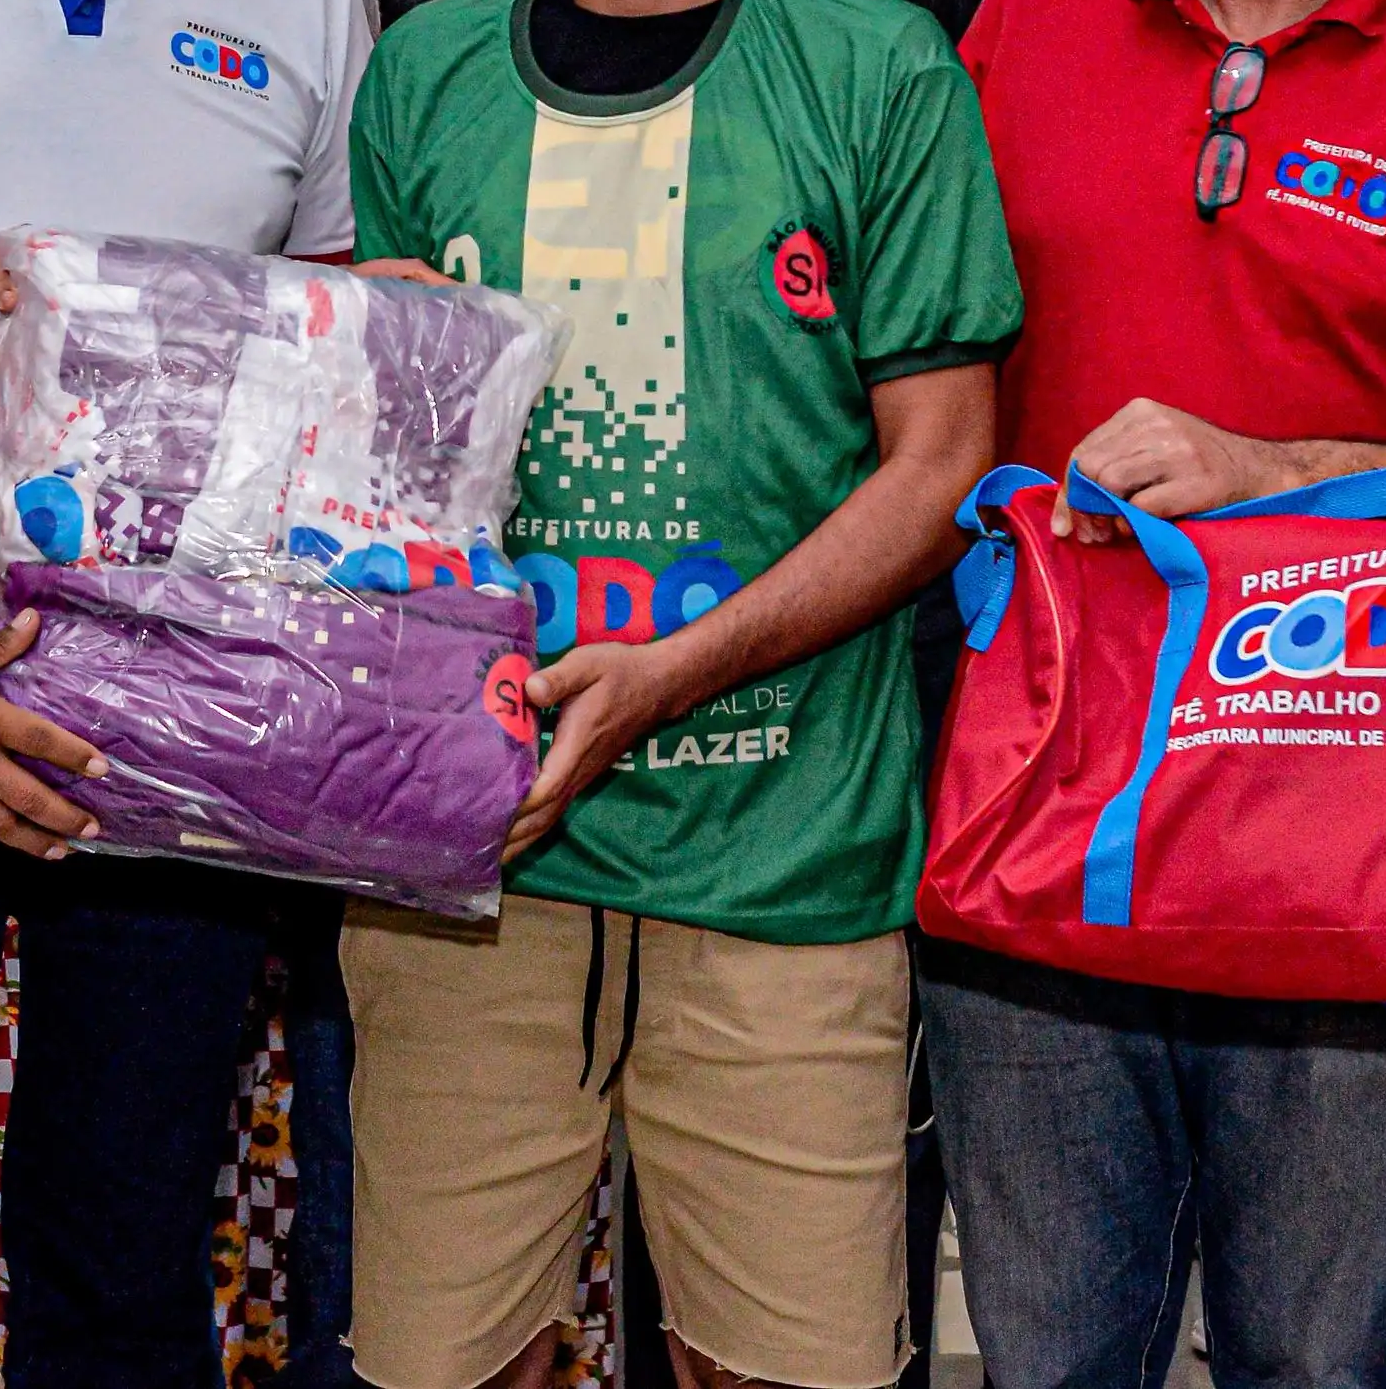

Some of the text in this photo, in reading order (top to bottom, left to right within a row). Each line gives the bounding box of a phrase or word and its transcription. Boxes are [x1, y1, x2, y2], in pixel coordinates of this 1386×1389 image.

[187, 21, 262, 52] PREFEITURA DE
[170, 31, 270, 91] CODÓ
[507, 517, 700, 541] EFEITURA DE
[754, 684, 792, 712] DE
[1170, 697, 1207, 727] FÉ,
[1215, 689, 1381, 717] TRABALHO
[647, 725, 791, 770] LAZER
[1167, 727, 1261, 752] SECRETARIA
[1262, 727, 1356, 746] MUNICIPAL
[1359, 729, 1385, 746] DE
